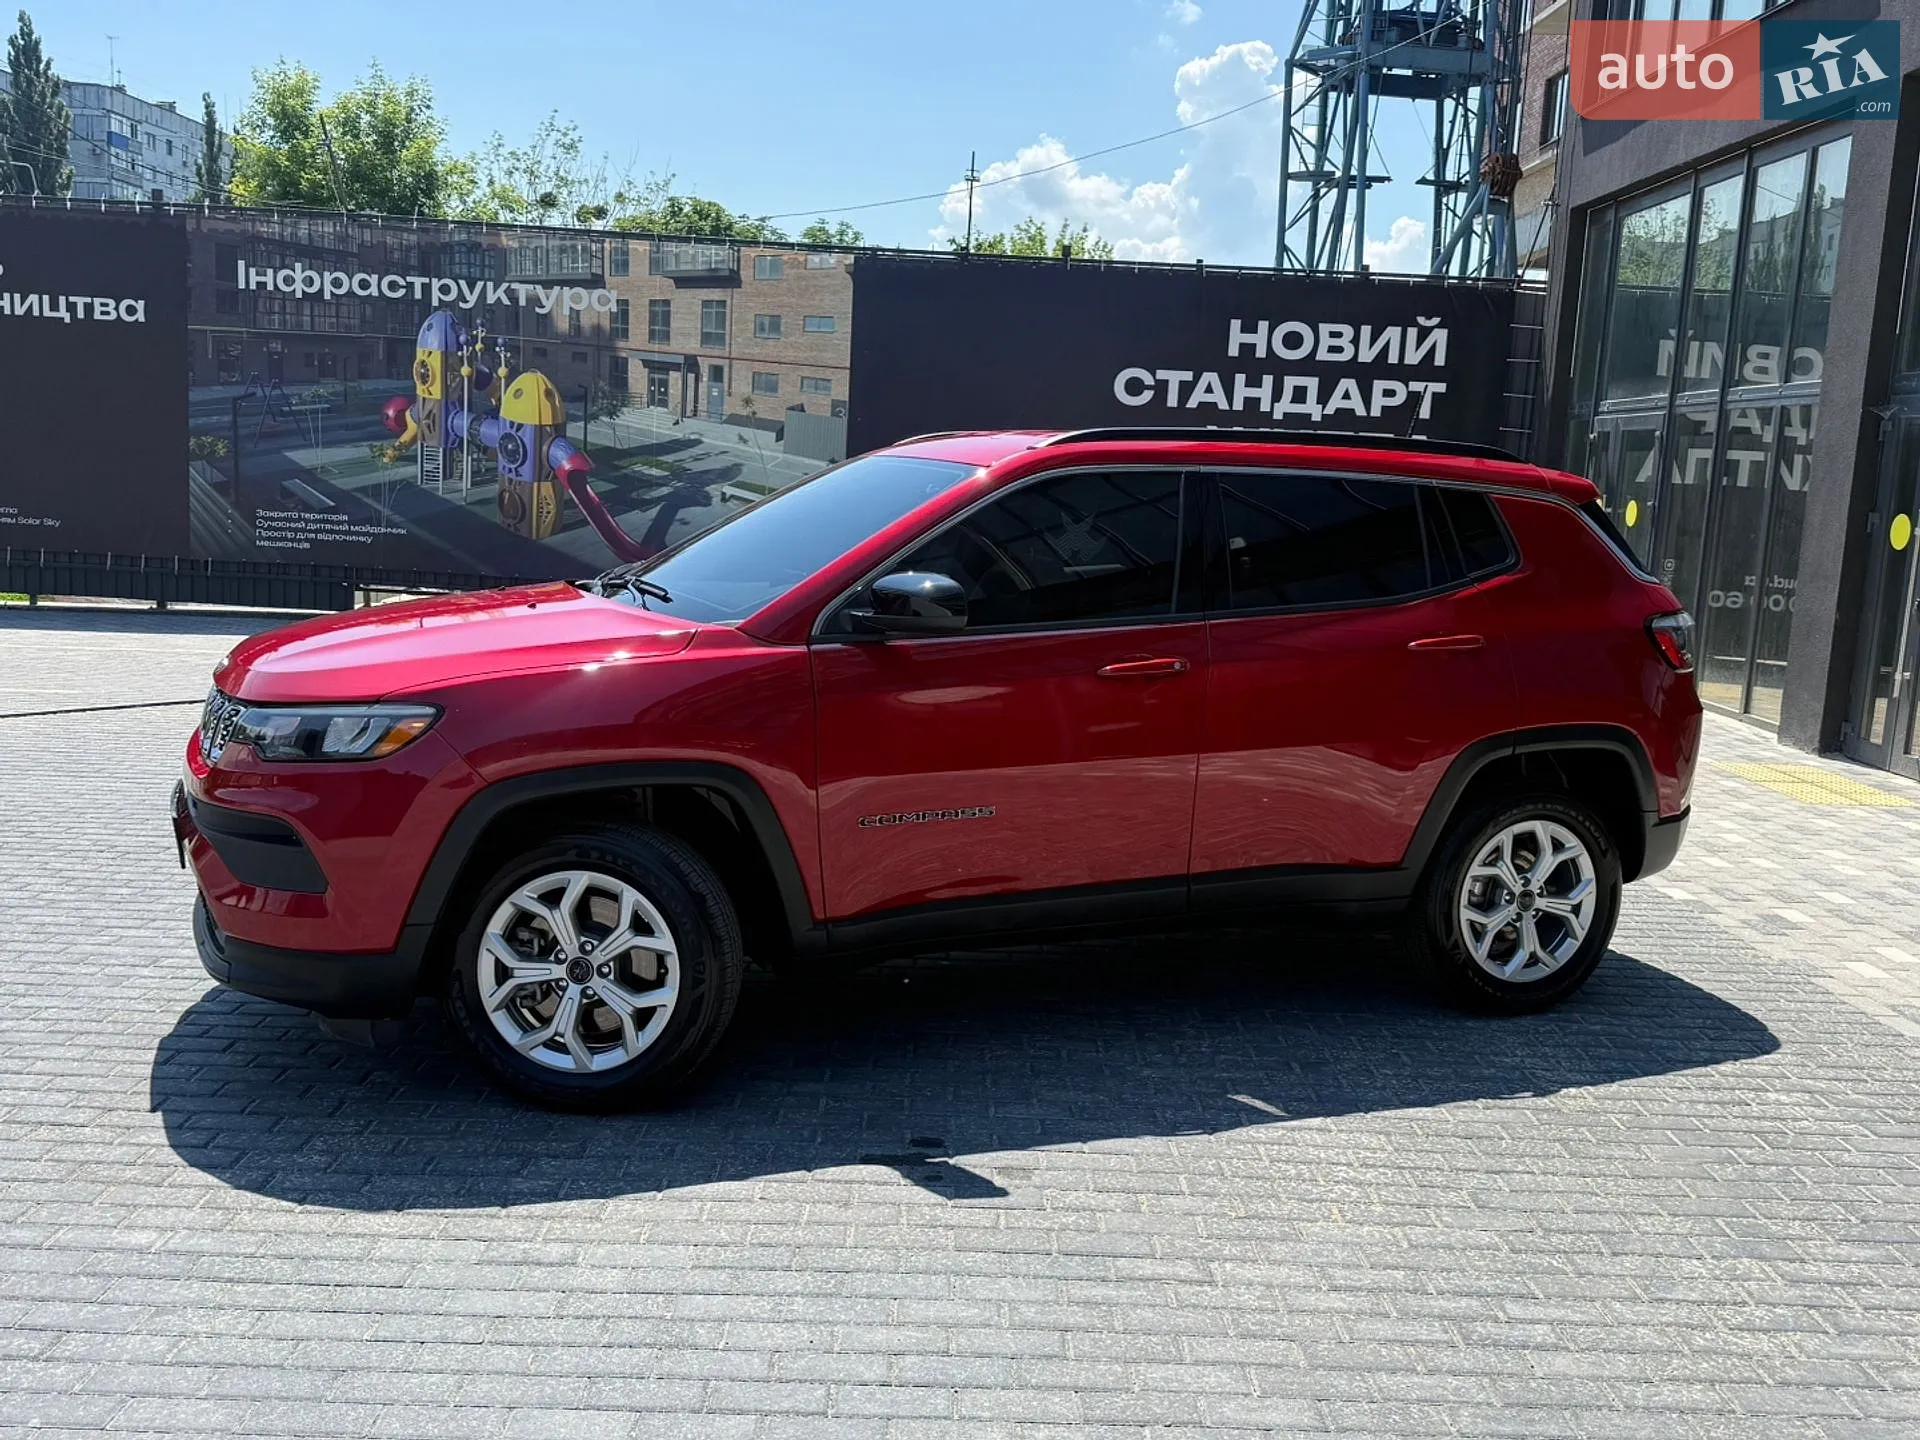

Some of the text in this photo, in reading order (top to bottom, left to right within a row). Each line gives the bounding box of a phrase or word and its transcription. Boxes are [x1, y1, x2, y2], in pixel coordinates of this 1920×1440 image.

[237, 260, 617, 315] Інфраструктура
[1227, 315, 1449, 367] НОВИЙ
[1113, 367, 1447, 422] СТАНДАРТ
[255, 509, 348, 521] Закрита територія
[255, 518, 408, 535] Сучасний дитячий майданчик
[255, 529, 295, 539] Простір
[296, 531, 316, 540] для
[858, 807, 996, 828] COMPASS
